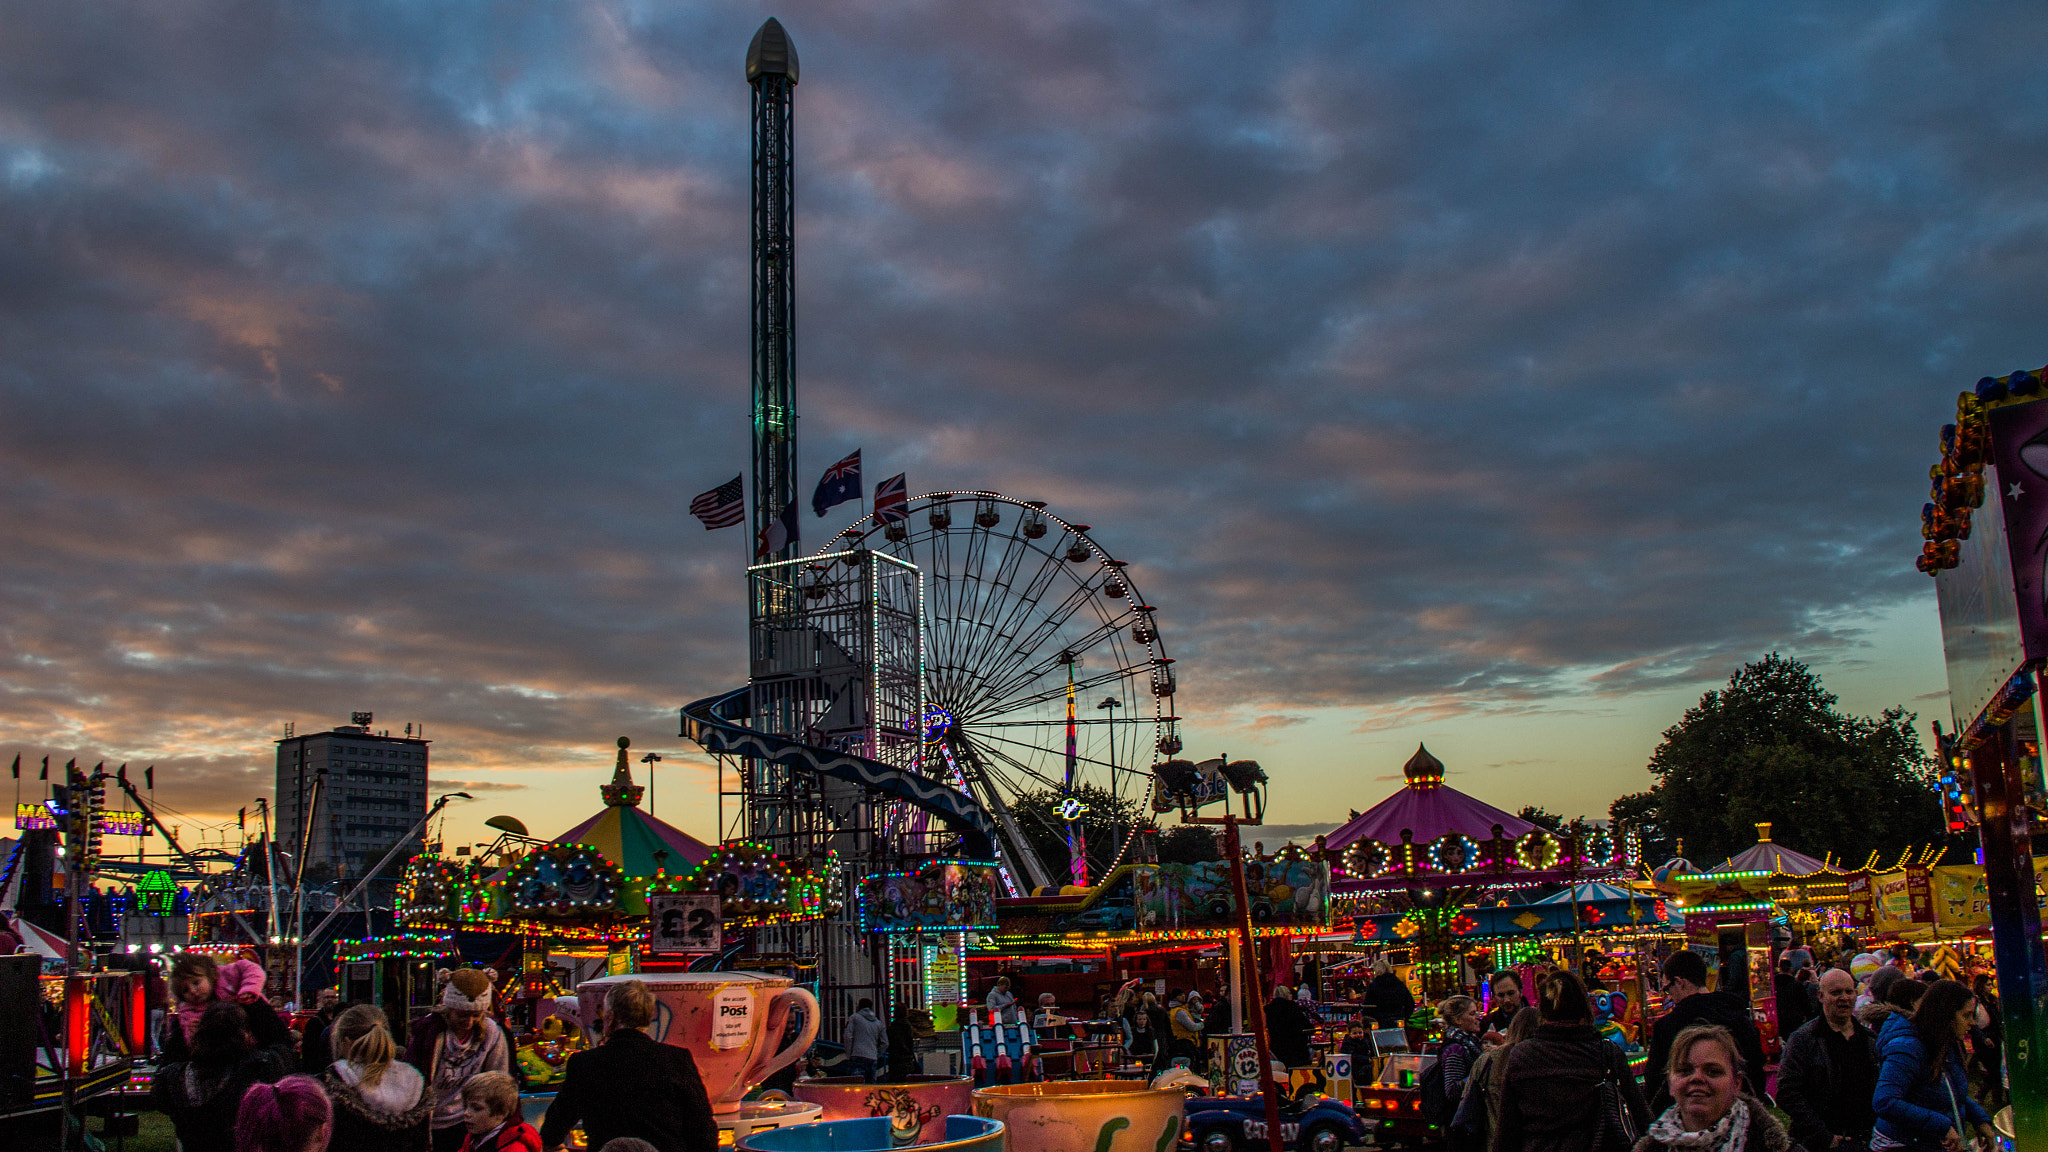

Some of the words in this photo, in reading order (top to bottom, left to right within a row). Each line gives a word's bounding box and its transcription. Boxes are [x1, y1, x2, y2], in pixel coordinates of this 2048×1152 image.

[661, 909, 715, 938] £2
[720, 1005, 748, 1016] Post
[1243, 1119, 1300, 1141] BATAN
